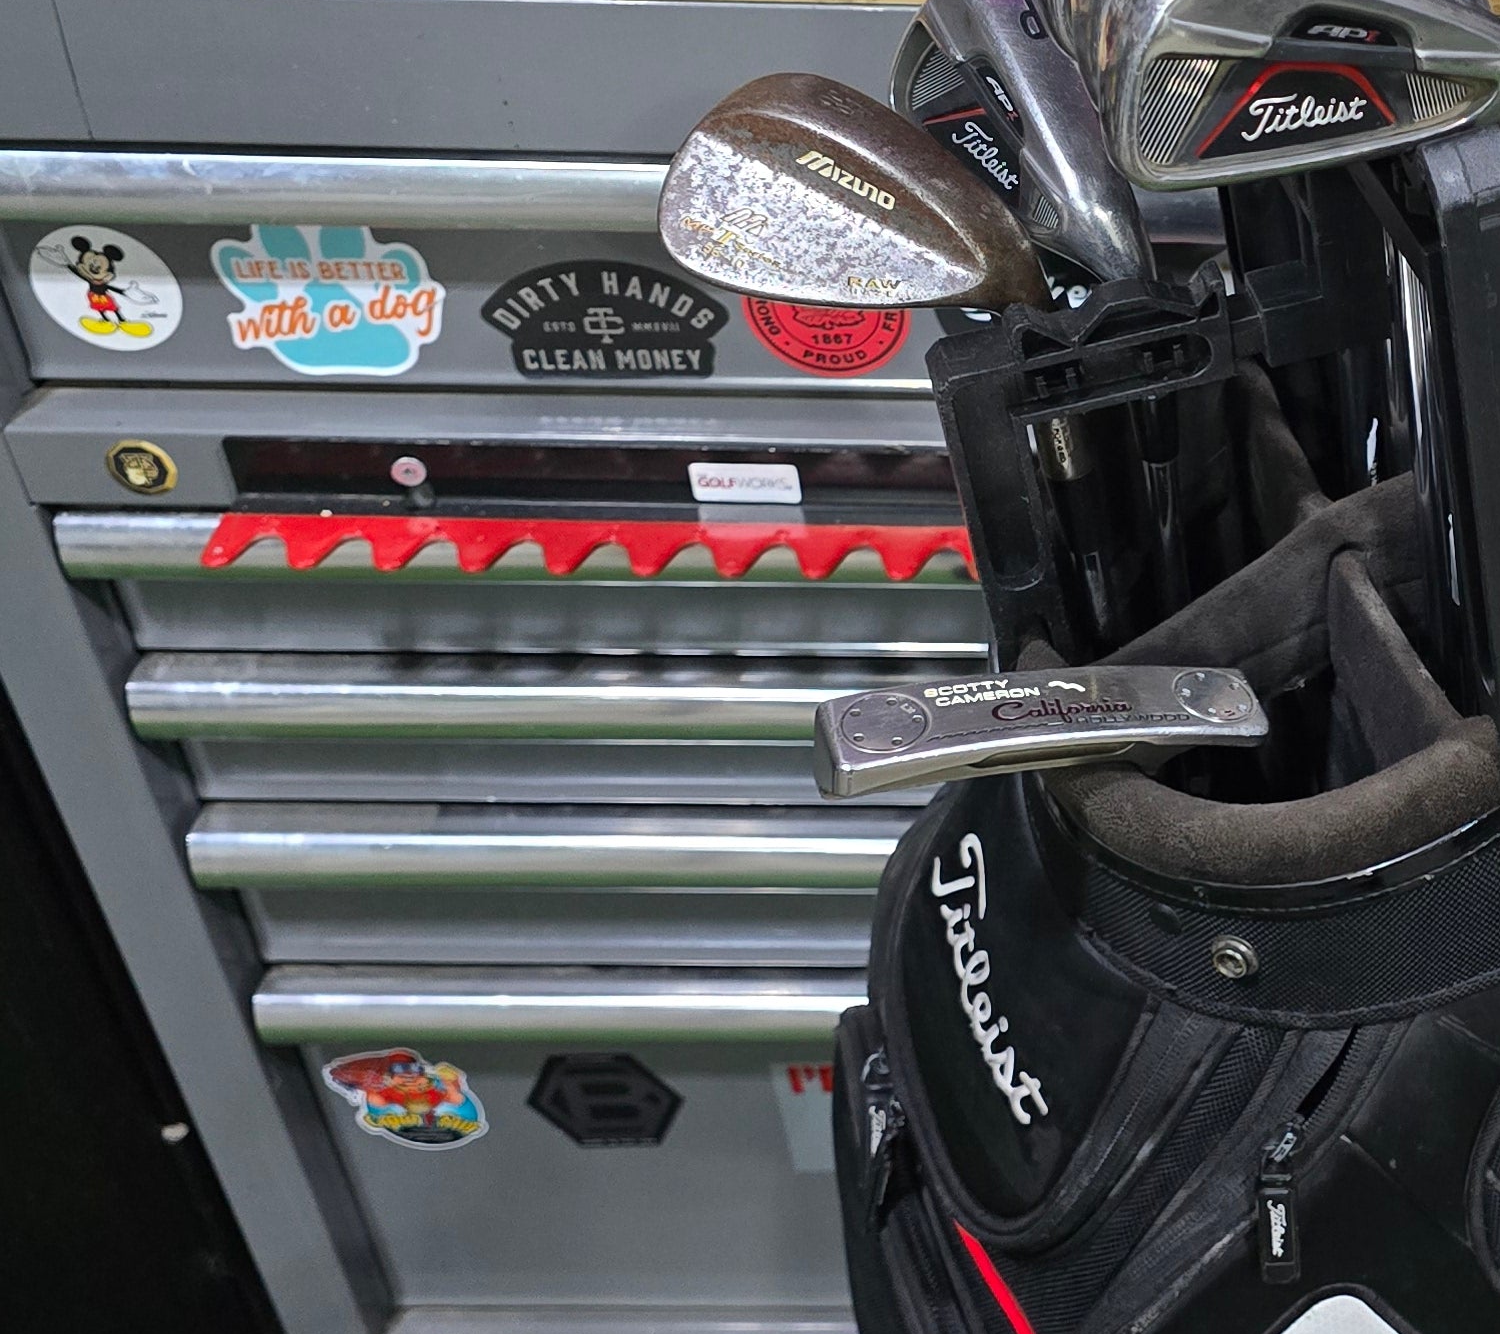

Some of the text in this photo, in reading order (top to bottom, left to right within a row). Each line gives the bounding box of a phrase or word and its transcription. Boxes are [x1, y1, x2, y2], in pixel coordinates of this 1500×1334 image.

[1241, 94, 1368, 142] Titleist
[952, 121, 1020, 192] Titleist
[796, 150, 897, 212] MIZUNO
[232, 260, 407, 282] LIFE IS BETTER
[847, 275, 902, 289] RAW
[237, 284, 438, 342] with a dog
[492, 271, 714, 331] DIRTY HANDS
[812, 334, 853, 345] 1867
[522, 349, 702, 371] CLEAN MONEY
[803, 350, 868, 365] PROUD
[923, 679, 1009, 699] SCOTTY
[935, 686, 1041, 708] CAMERON
[991, 698, 1133, 725] California
[932, 833, 1049, 1126] Titleist
